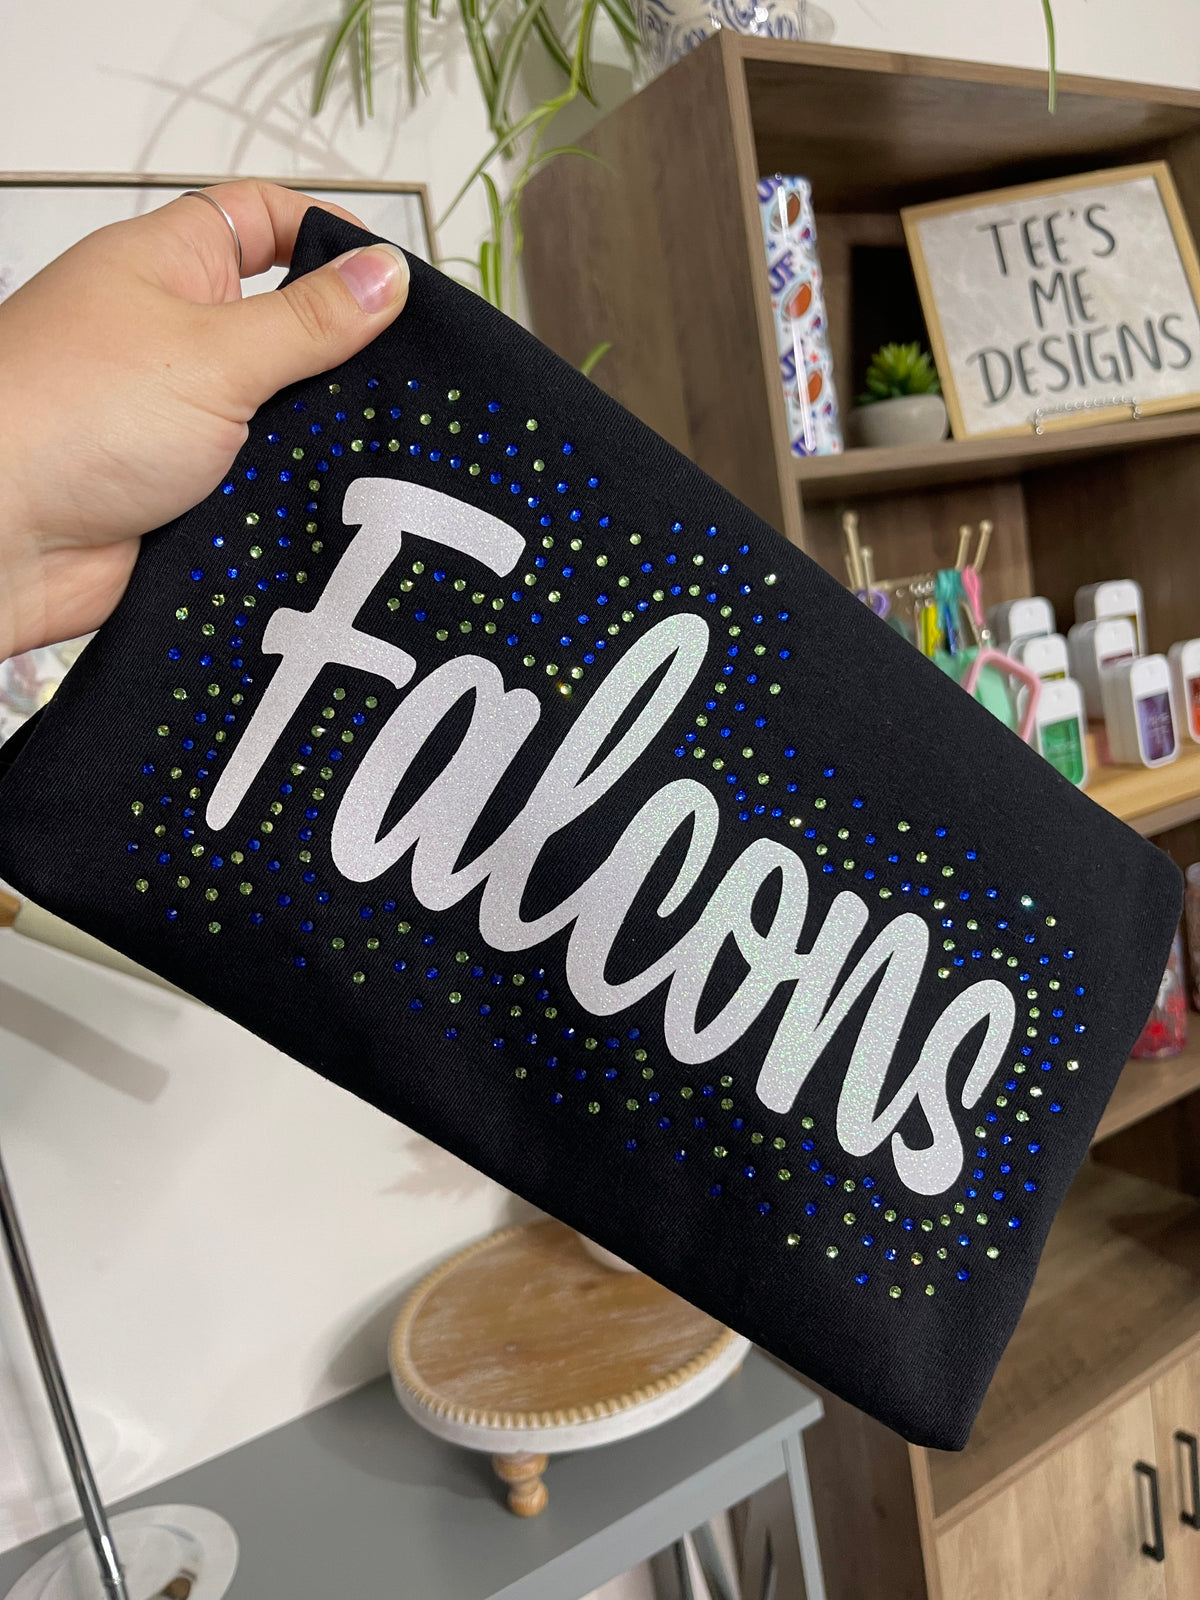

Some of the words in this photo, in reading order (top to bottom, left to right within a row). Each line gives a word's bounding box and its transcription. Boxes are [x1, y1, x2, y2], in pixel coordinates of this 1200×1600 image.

[976, 204, 1115, 277] TEE'S
[1029, 267, 1099, 329] ME
[966, 313, 1192, 408] DESIGNS
[205, 477, 1016, 1195] Falcons
